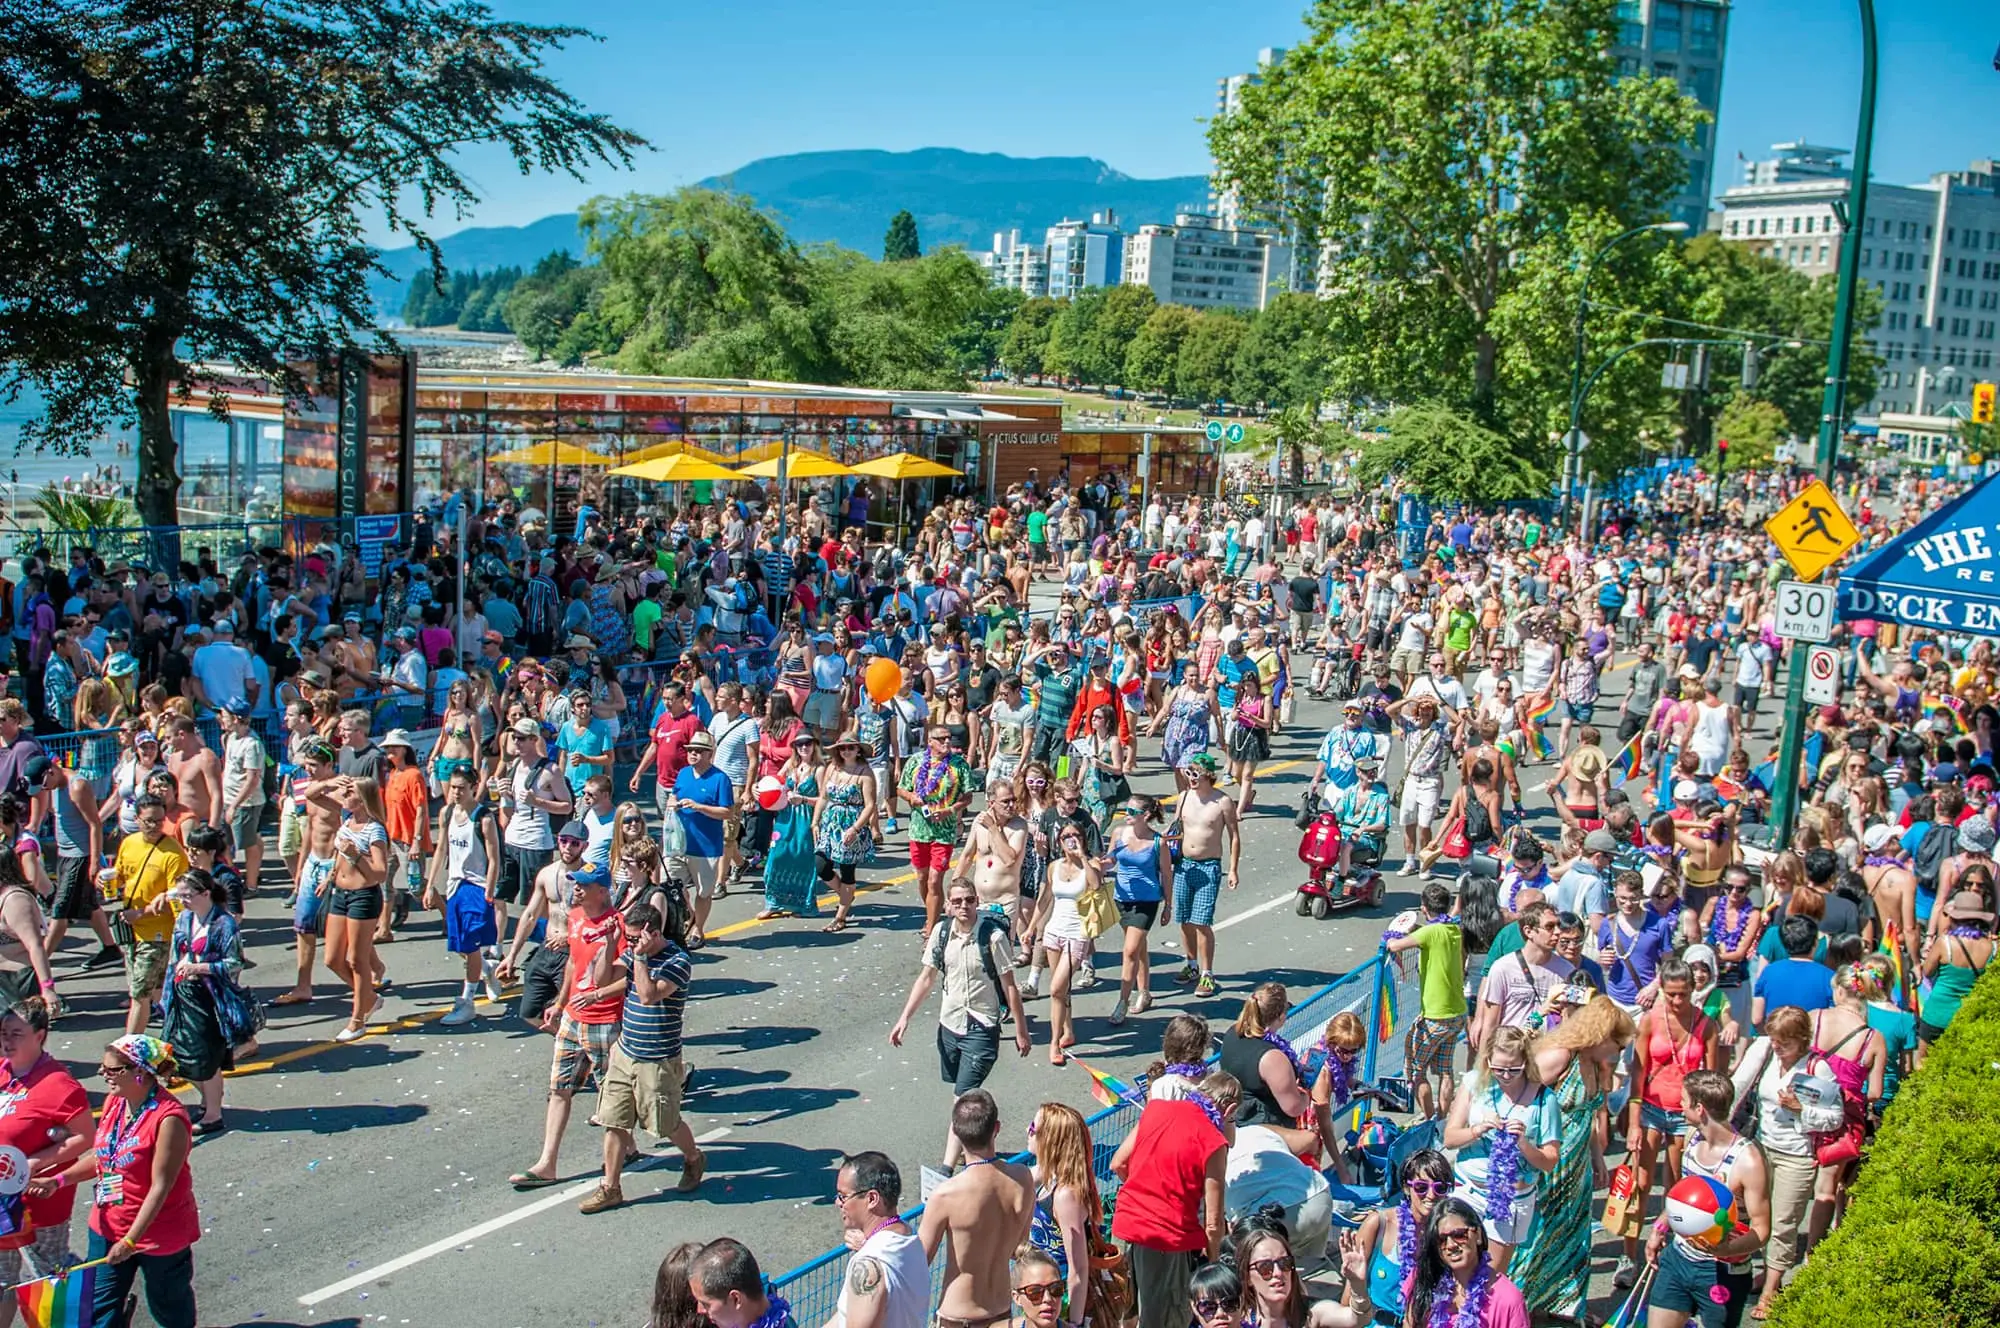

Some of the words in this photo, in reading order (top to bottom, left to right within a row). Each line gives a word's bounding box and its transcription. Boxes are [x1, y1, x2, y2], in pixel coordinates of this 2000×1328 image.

[1019, 432, 1038, 445] CLUB
[1040, 432, 1059, 445] CAFE
[1907, 526, 1992, 573] THE
[1784, 589, 1824, 618] 30
[1848, 587, 1953, 625] DECK
[1783, 620, 1821, 634] km/h
[1062, 675, 1071, 687] 9
